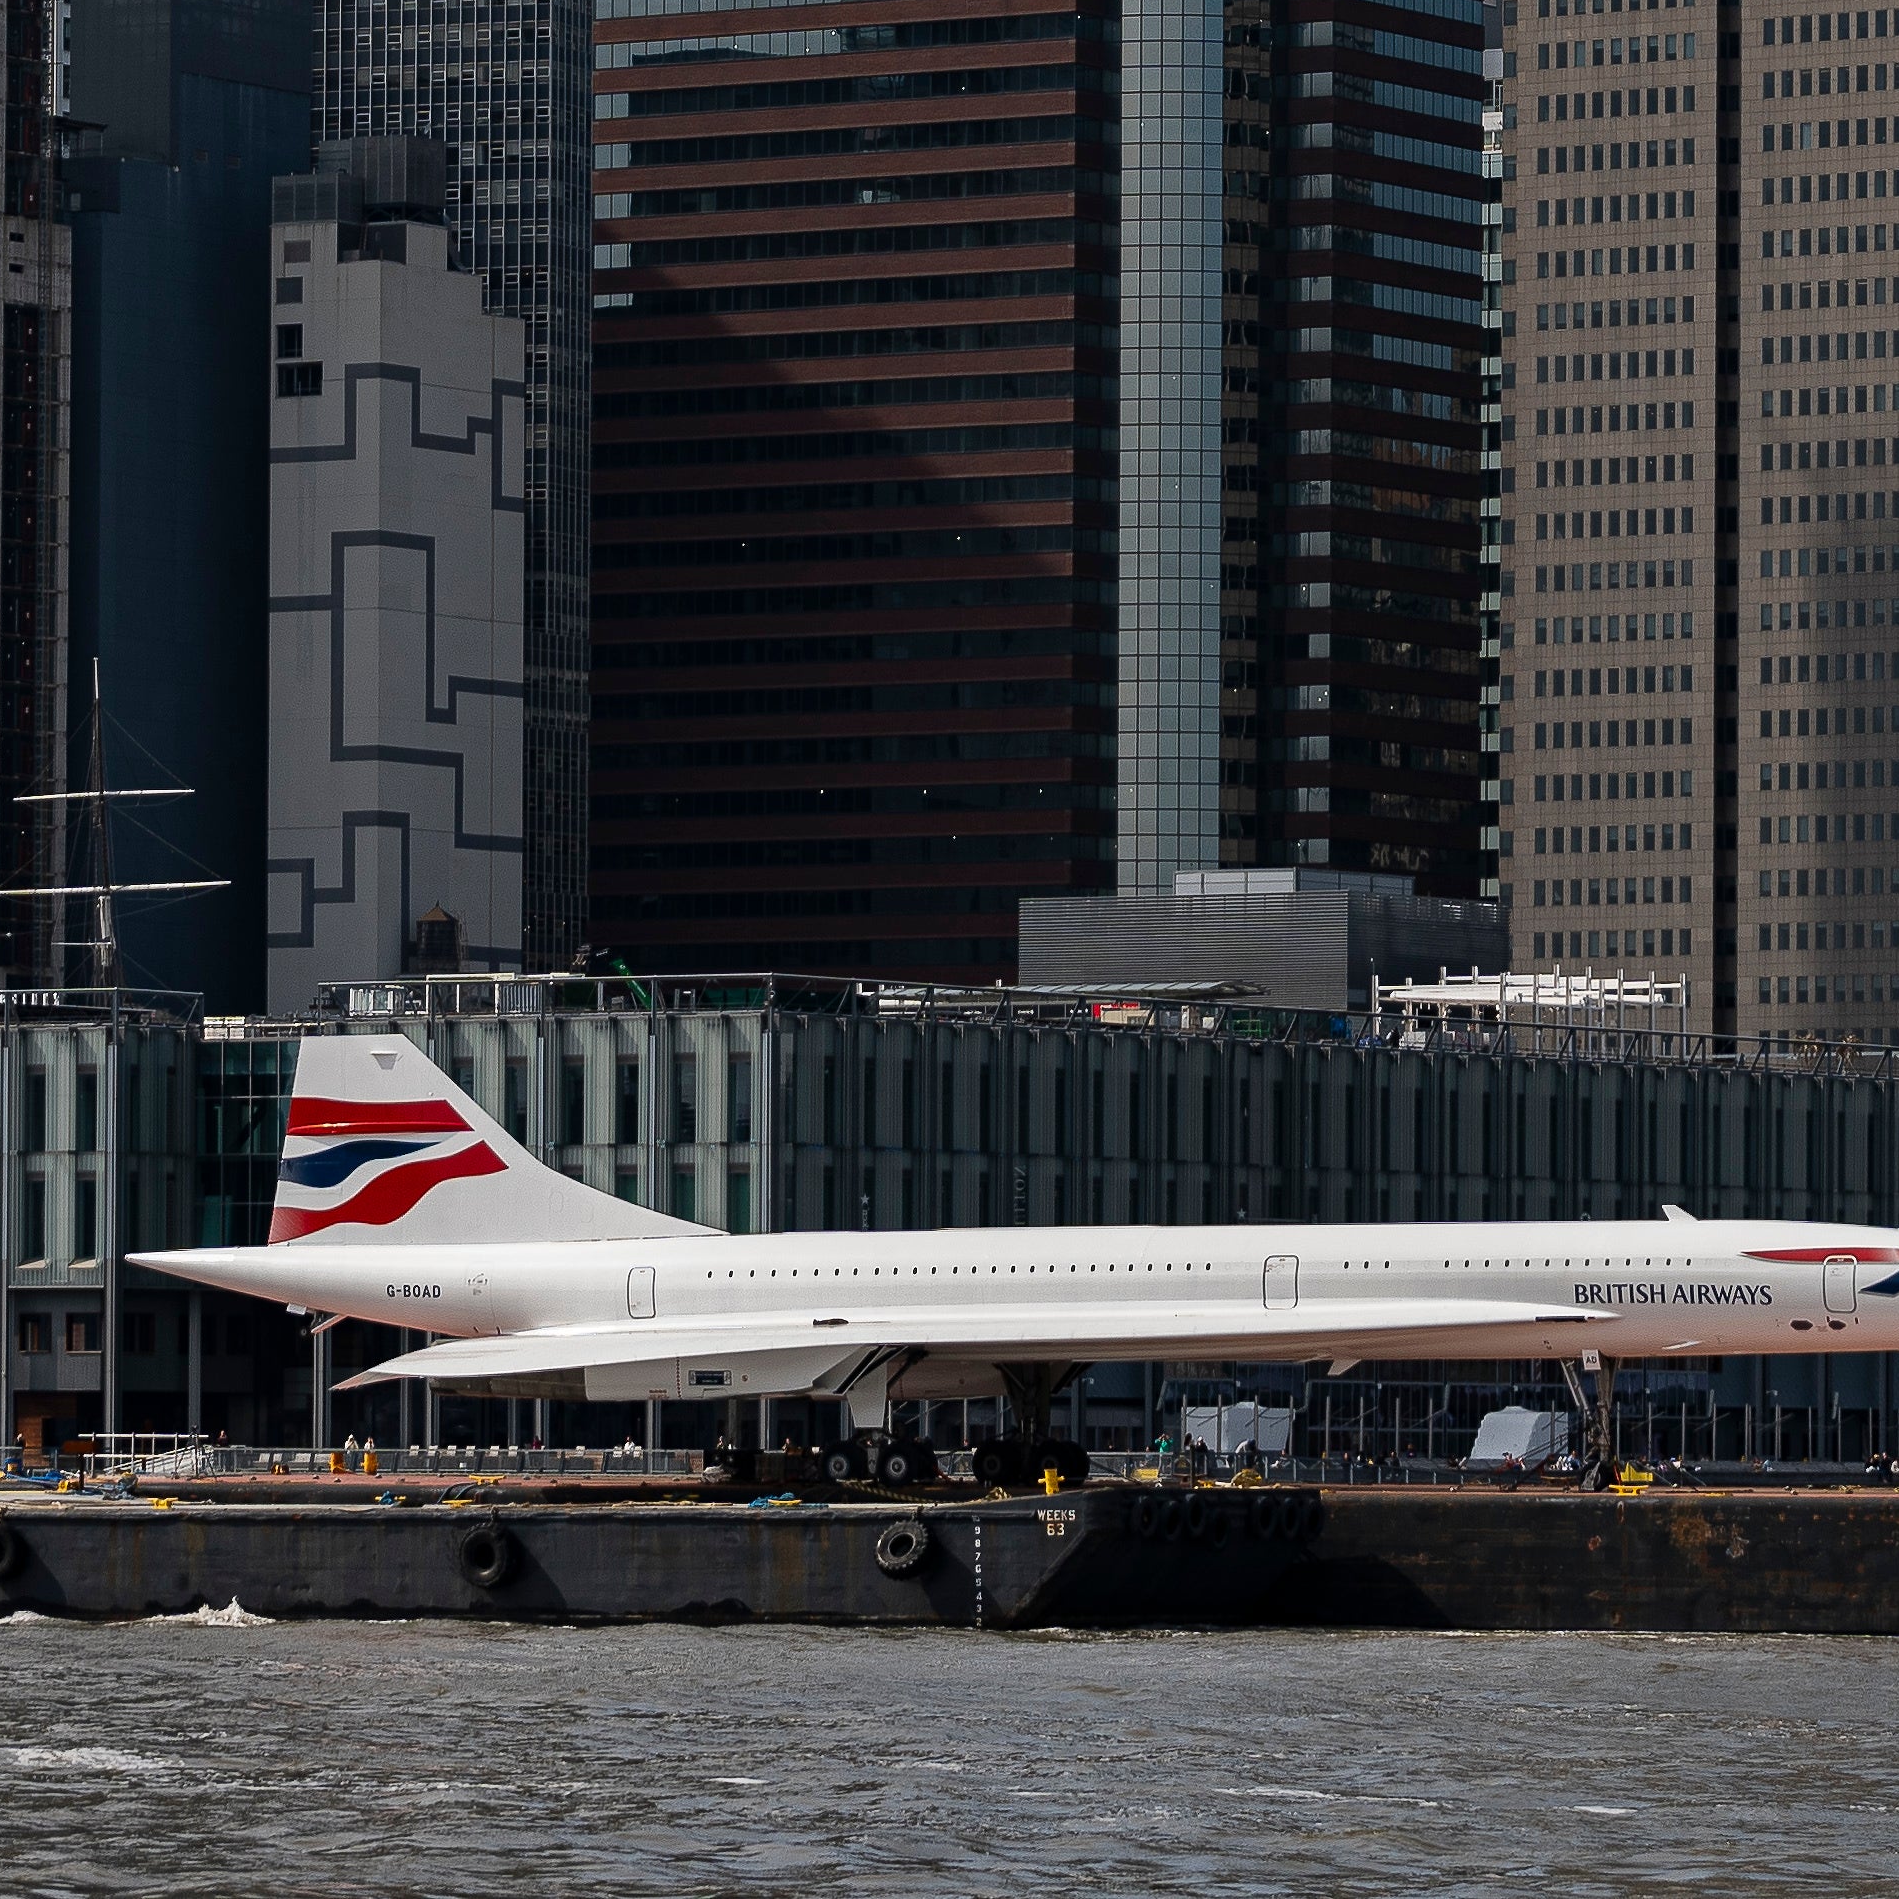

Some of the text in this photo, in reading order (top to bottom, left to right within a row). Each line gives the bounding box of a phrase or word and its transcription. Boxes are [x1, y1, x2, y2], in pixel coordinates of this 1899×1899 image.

[386, 1284, 442, 1298] G-BOAD
[1573, 1283, 1773, 1306] BRITISH AIRWAYS
[1037, 1509, 1076, 1521] WEEKS
[1046, 1522, 1065, 1536] 63
